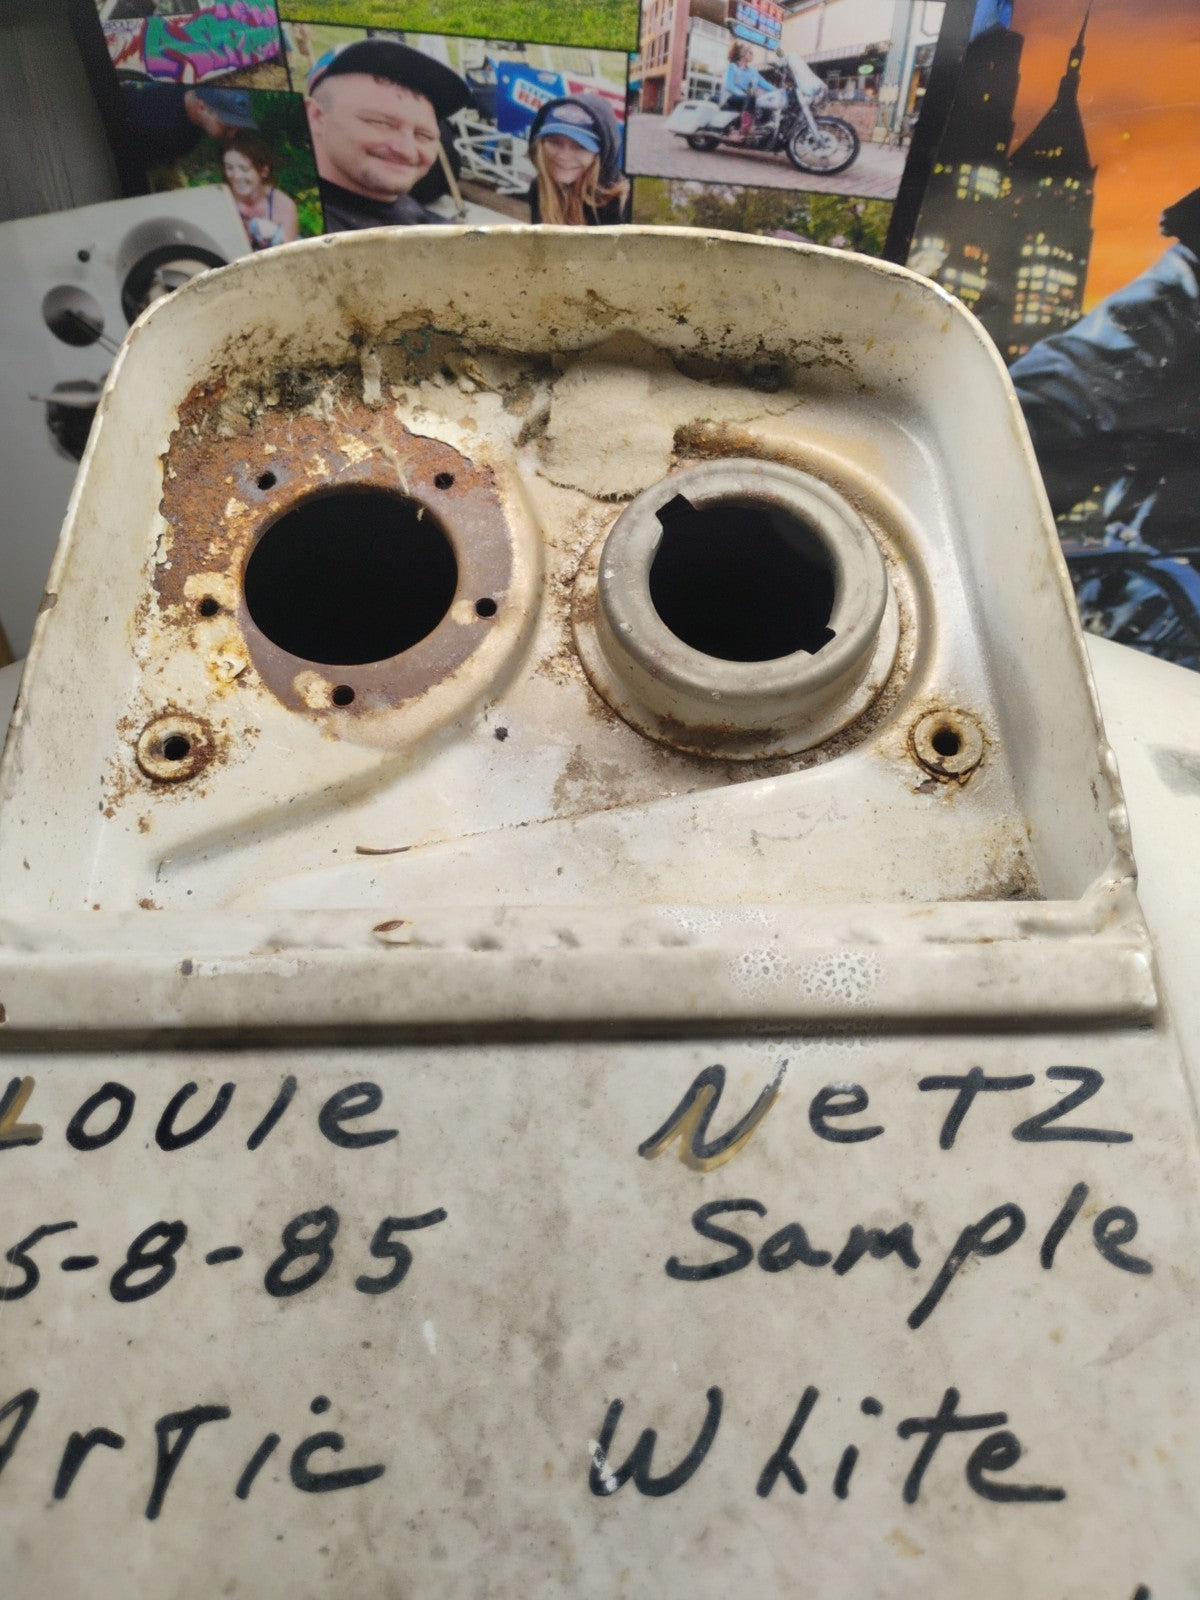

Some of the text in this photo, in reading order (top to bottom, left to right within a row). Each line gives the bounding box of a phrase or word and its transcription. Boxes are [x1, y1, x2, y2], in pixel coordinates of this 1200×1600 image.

[0, 1181, 1153, 1330] 5-8-85 Sample
[588, 1385, 1066, 1502] White
